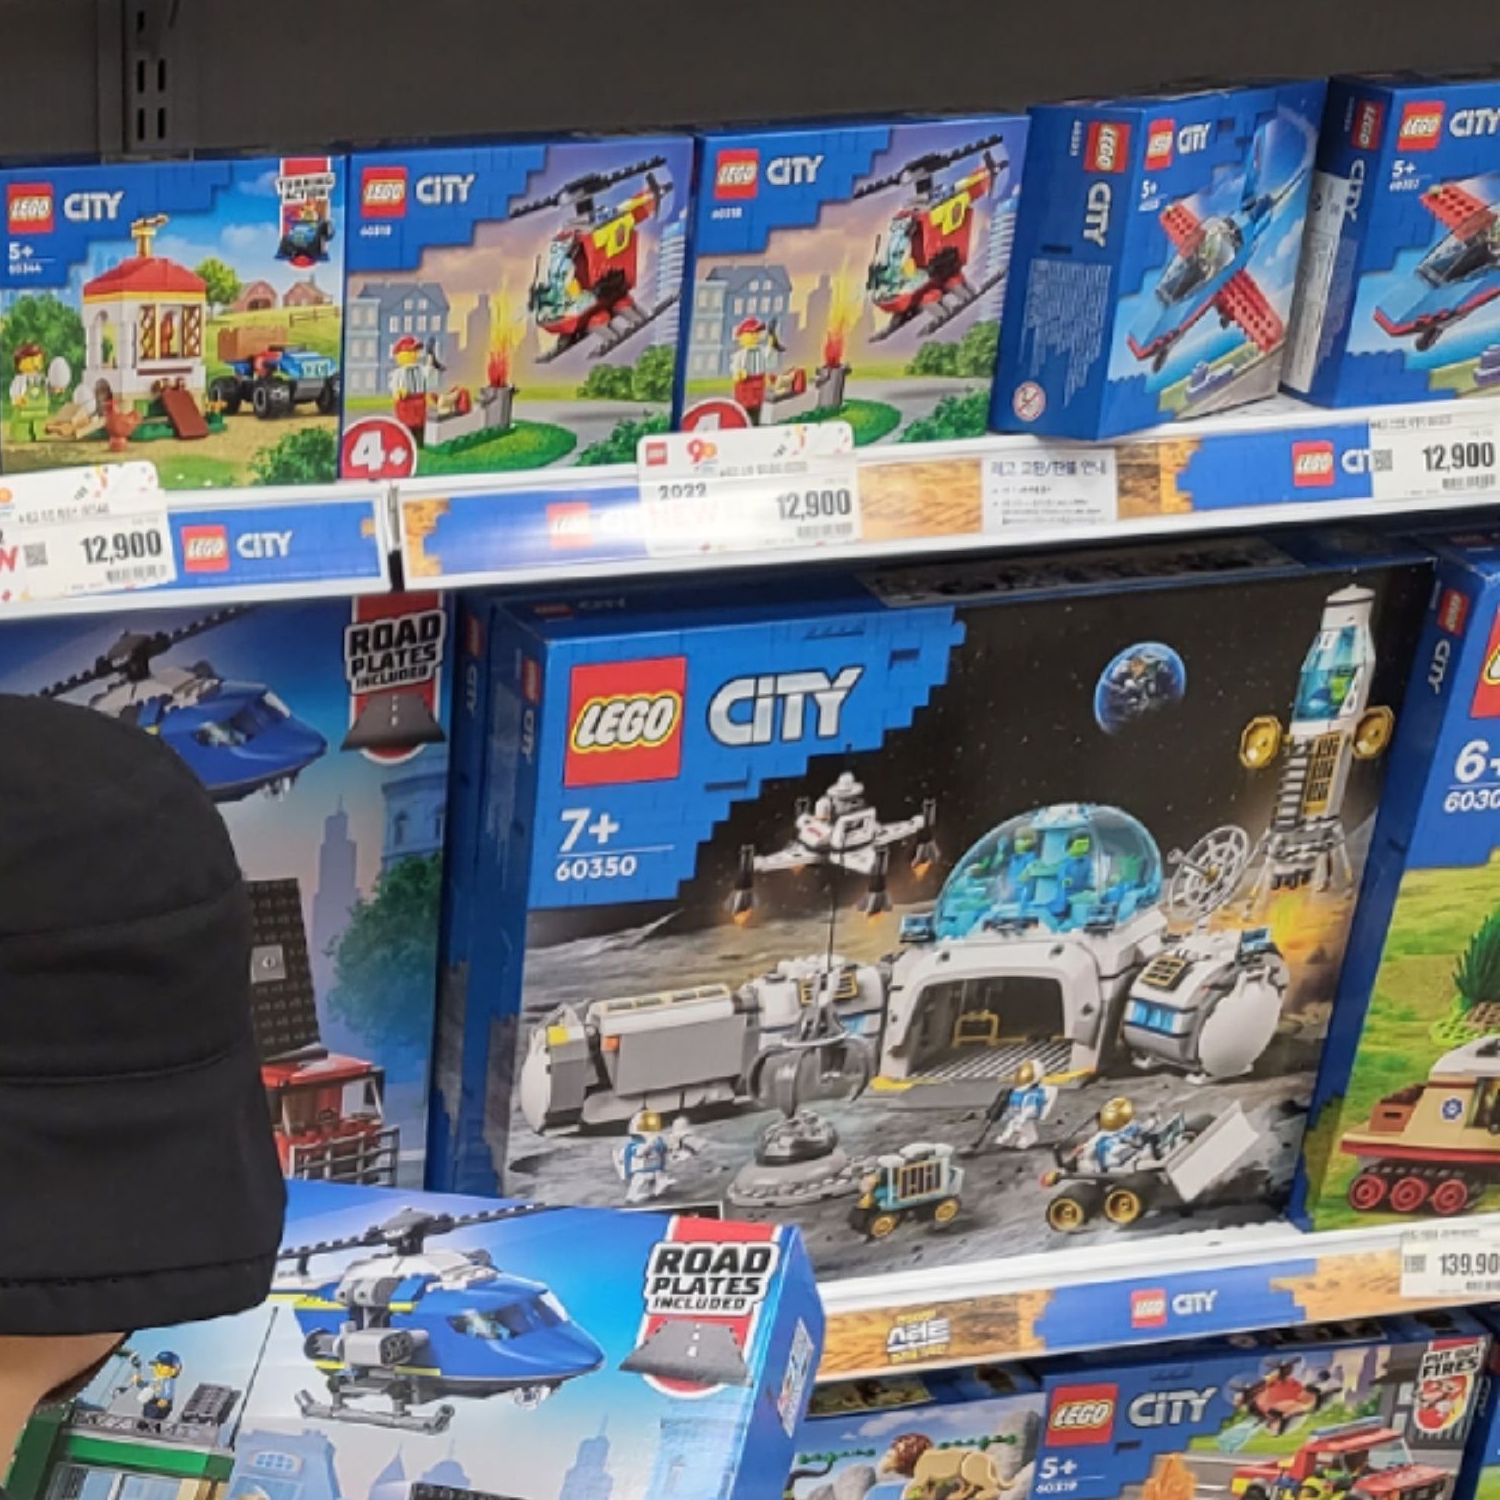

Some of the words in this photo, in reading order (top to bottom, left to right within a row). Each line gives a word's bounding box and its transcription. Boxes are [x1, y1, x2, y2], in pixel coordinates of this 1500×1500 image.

[1401, 114, 1442, 137] LEGO
[715, 161, 757, 188] LEGO
[766, 155, 824, 186] CITY
[1392, 160, 1416, 178] 5+
[415, 173, 475, 204] CITY
[63, 191, 124, 221] CITY
[1083, 181, 1111, 247] CITY
[8, 243, 35, 261] 5+
[350, 431, 408, 473] 4+
[1422, 441, 1496, 473] 12,900
[658, 482, 707, 501] 2022
[777, 488, 851, 521] 12,900
[81, 529, 163, 566] 12,900
[185, 535, 225, 560] LEGO
[236, 531, 293, 559] CITY
[351, 614, 441, 656] ROAD
[351, 643, 437, 678] PLATES
[570, 690, 682, 754] LEGO
[706, 665, 866, 747] CITY
[559, 808, 620, 853] 7+
[555, 855, 638, 882] 60350
[653, 1247, 771, 1275] ROAD
[651, 1276, 760, 1296] PLATES
[653, 1297, 746, 1310] INCLUDED
[1172, 1290, 1218, 1316] CITY
[1050, 1399, 1115, 1431] LEGO
[1128, 1386, 1219, 1427] CITY
[1038, 1456, 1077, 1479] 5+
